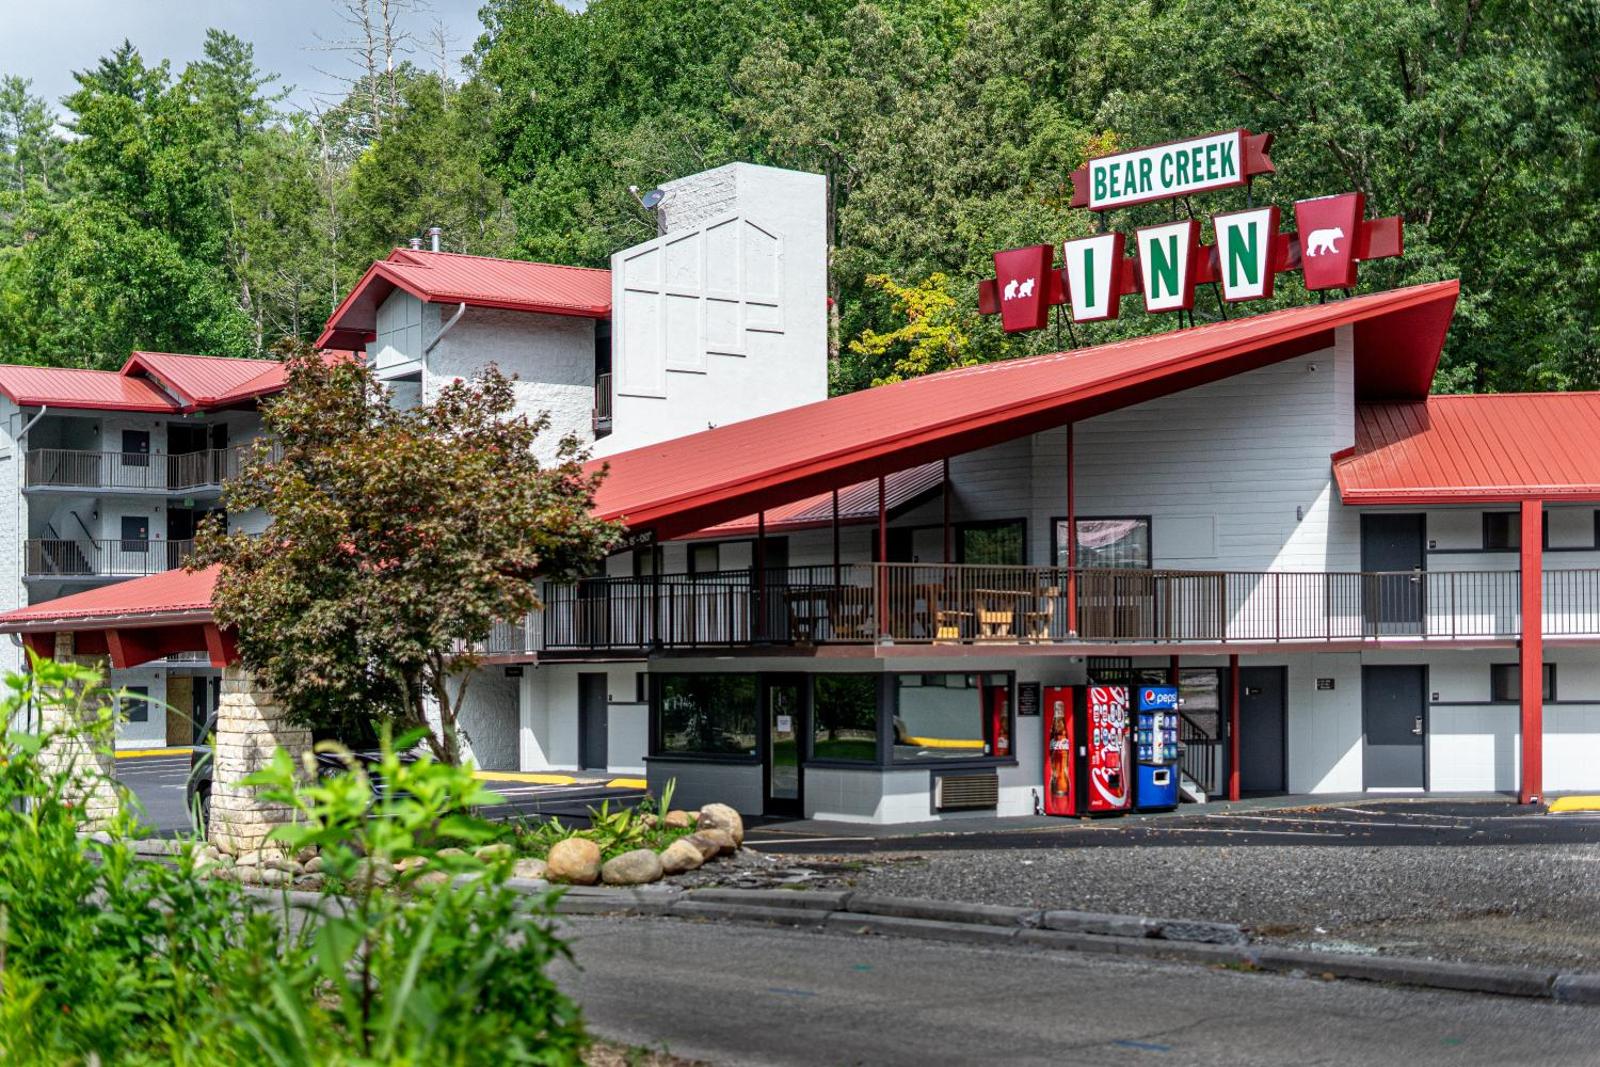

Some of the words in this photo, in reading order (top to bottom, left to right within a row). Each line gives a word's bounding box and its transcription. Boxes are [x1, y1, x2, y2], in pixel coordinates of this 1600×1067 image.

[1094, 157, 1153, 201] BEAR
[1160, 140, 1236, 189] CREEK
[1084, 221, 1258, 308] INN
